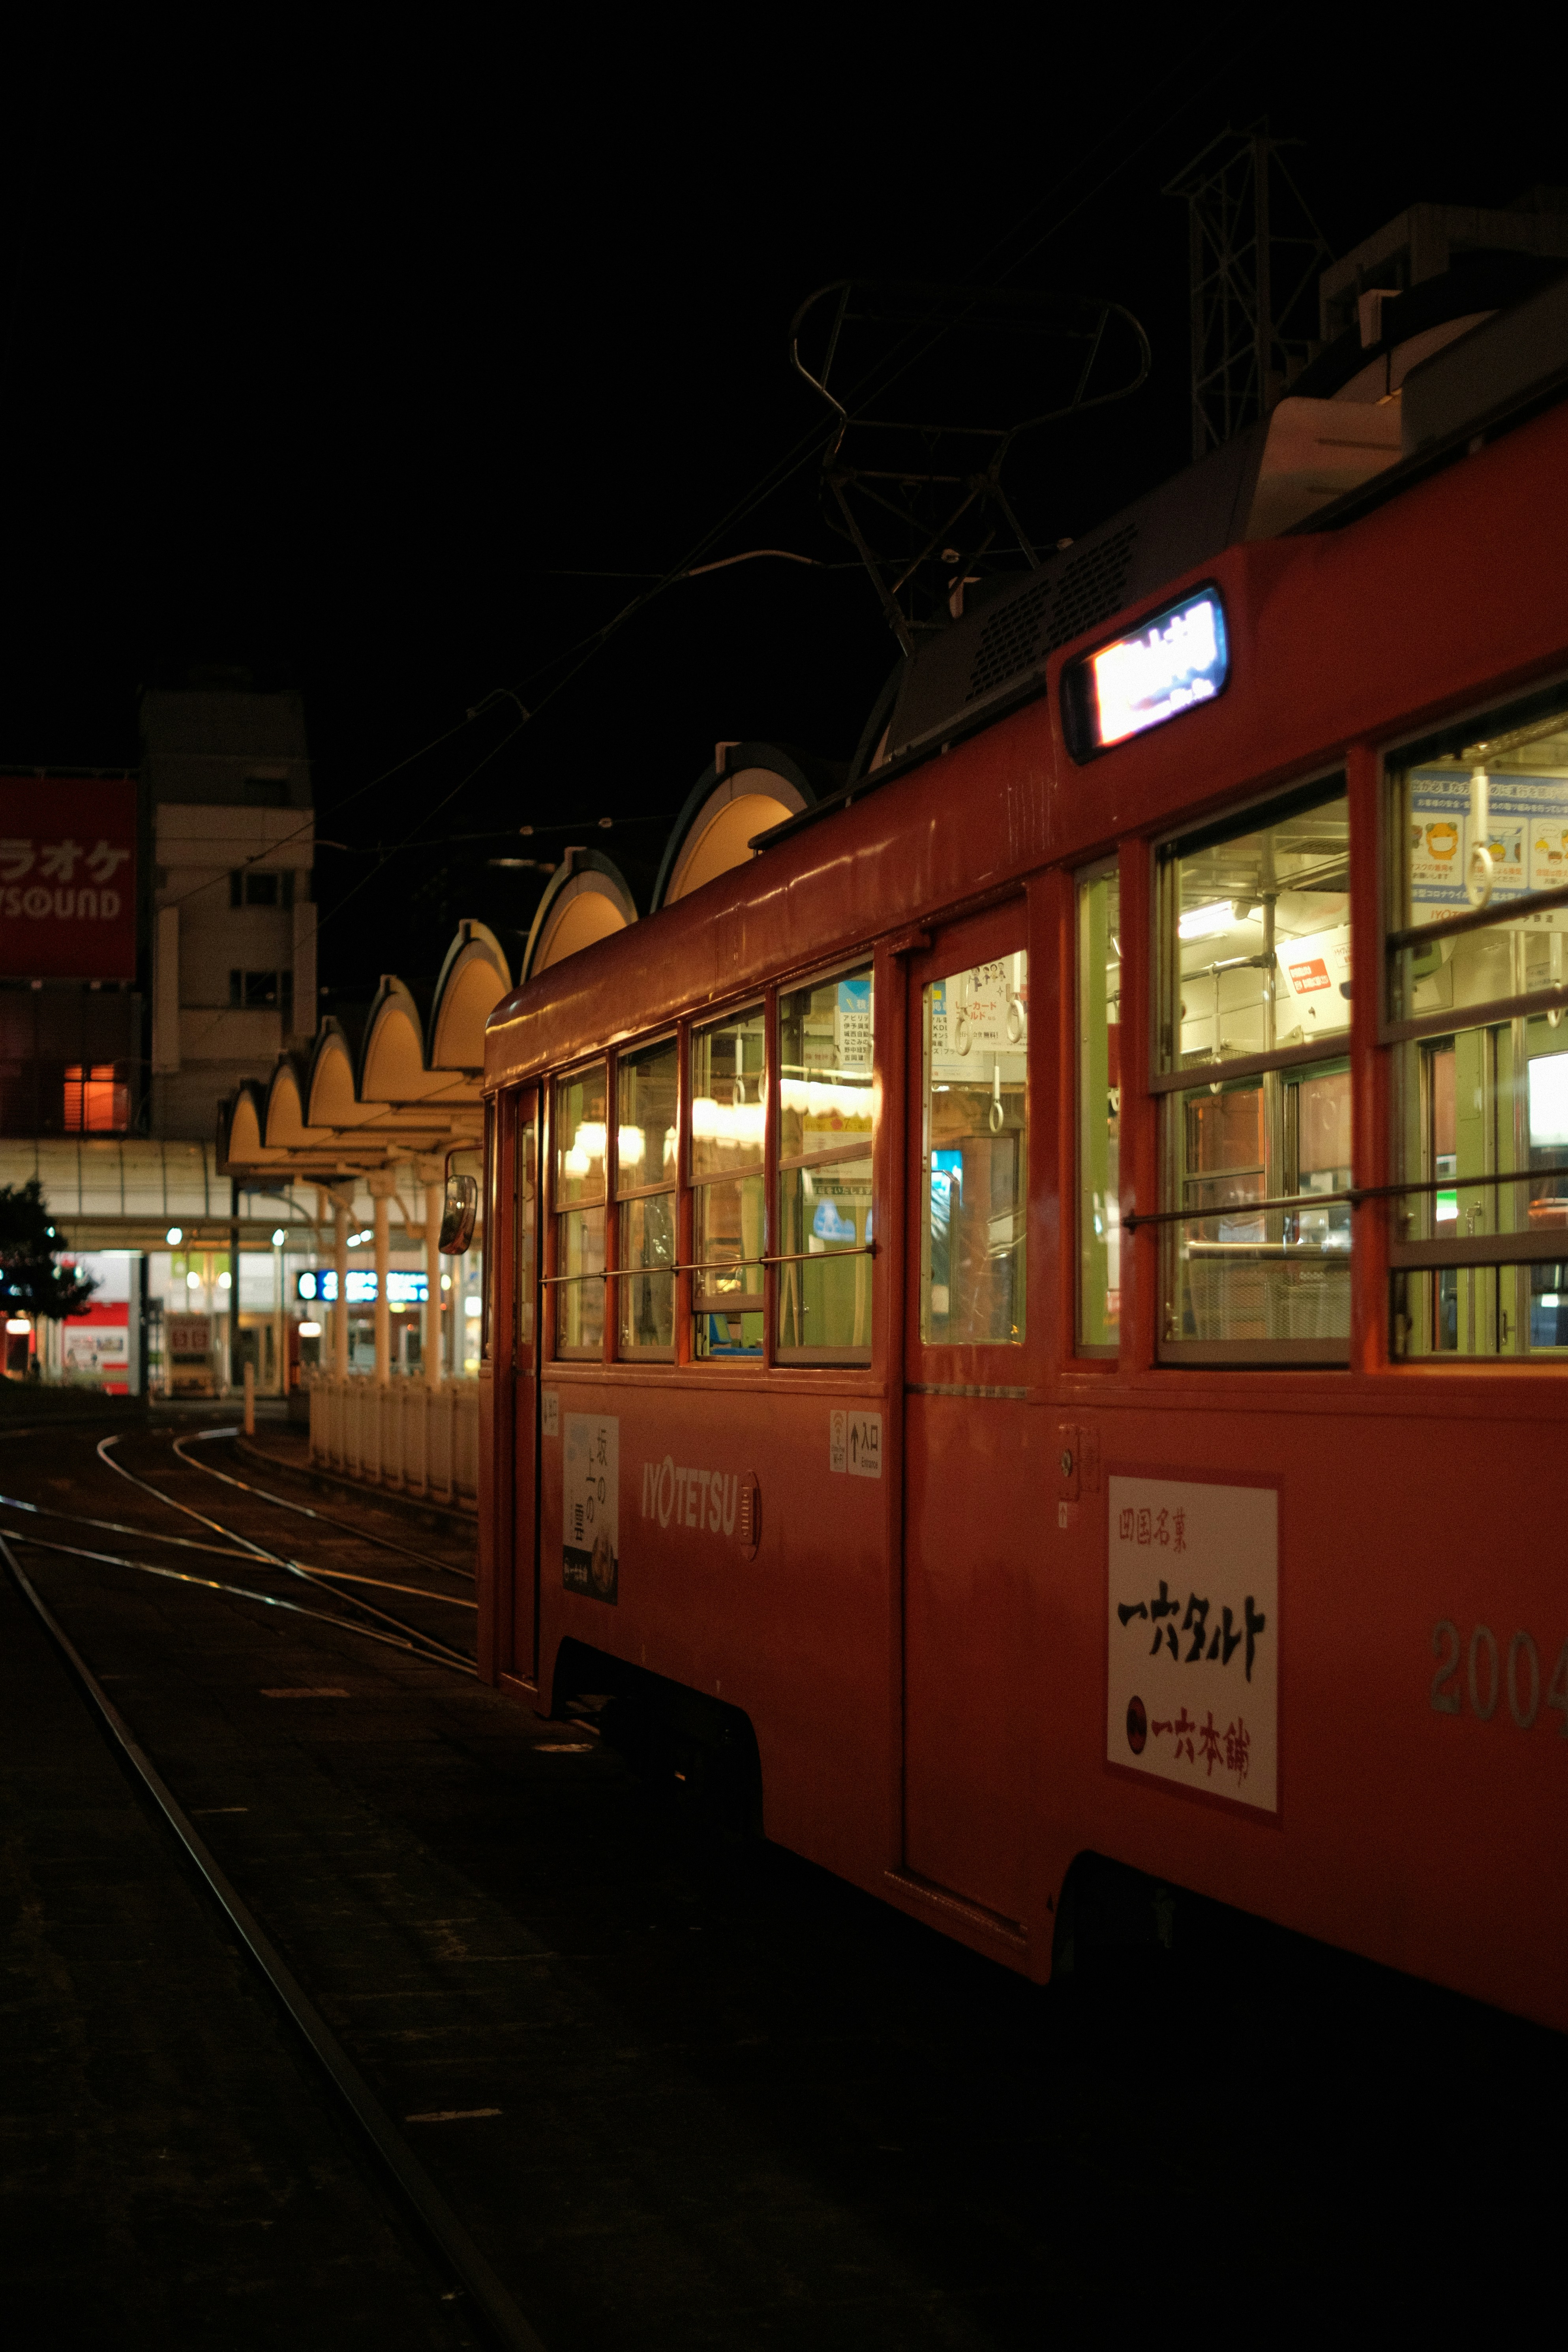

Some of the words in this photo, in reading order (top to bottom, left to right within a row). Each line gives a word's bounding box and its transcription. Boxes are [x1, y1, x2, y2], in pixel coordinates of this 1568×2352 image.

[0, 838, 131, 883] ラオケ
[861, 1422, 878, 1452] 入口
[642, 1454, 737, 1536] IYOTETSU
[1120, 1507, 1186, 1553] 四国名菓
[1118, 1580, 1266, 1683] 一六タルト
[1431, 1619, 1568, 1737] 2004
[1152, 1707, 1251, 1788] 一六本舗
